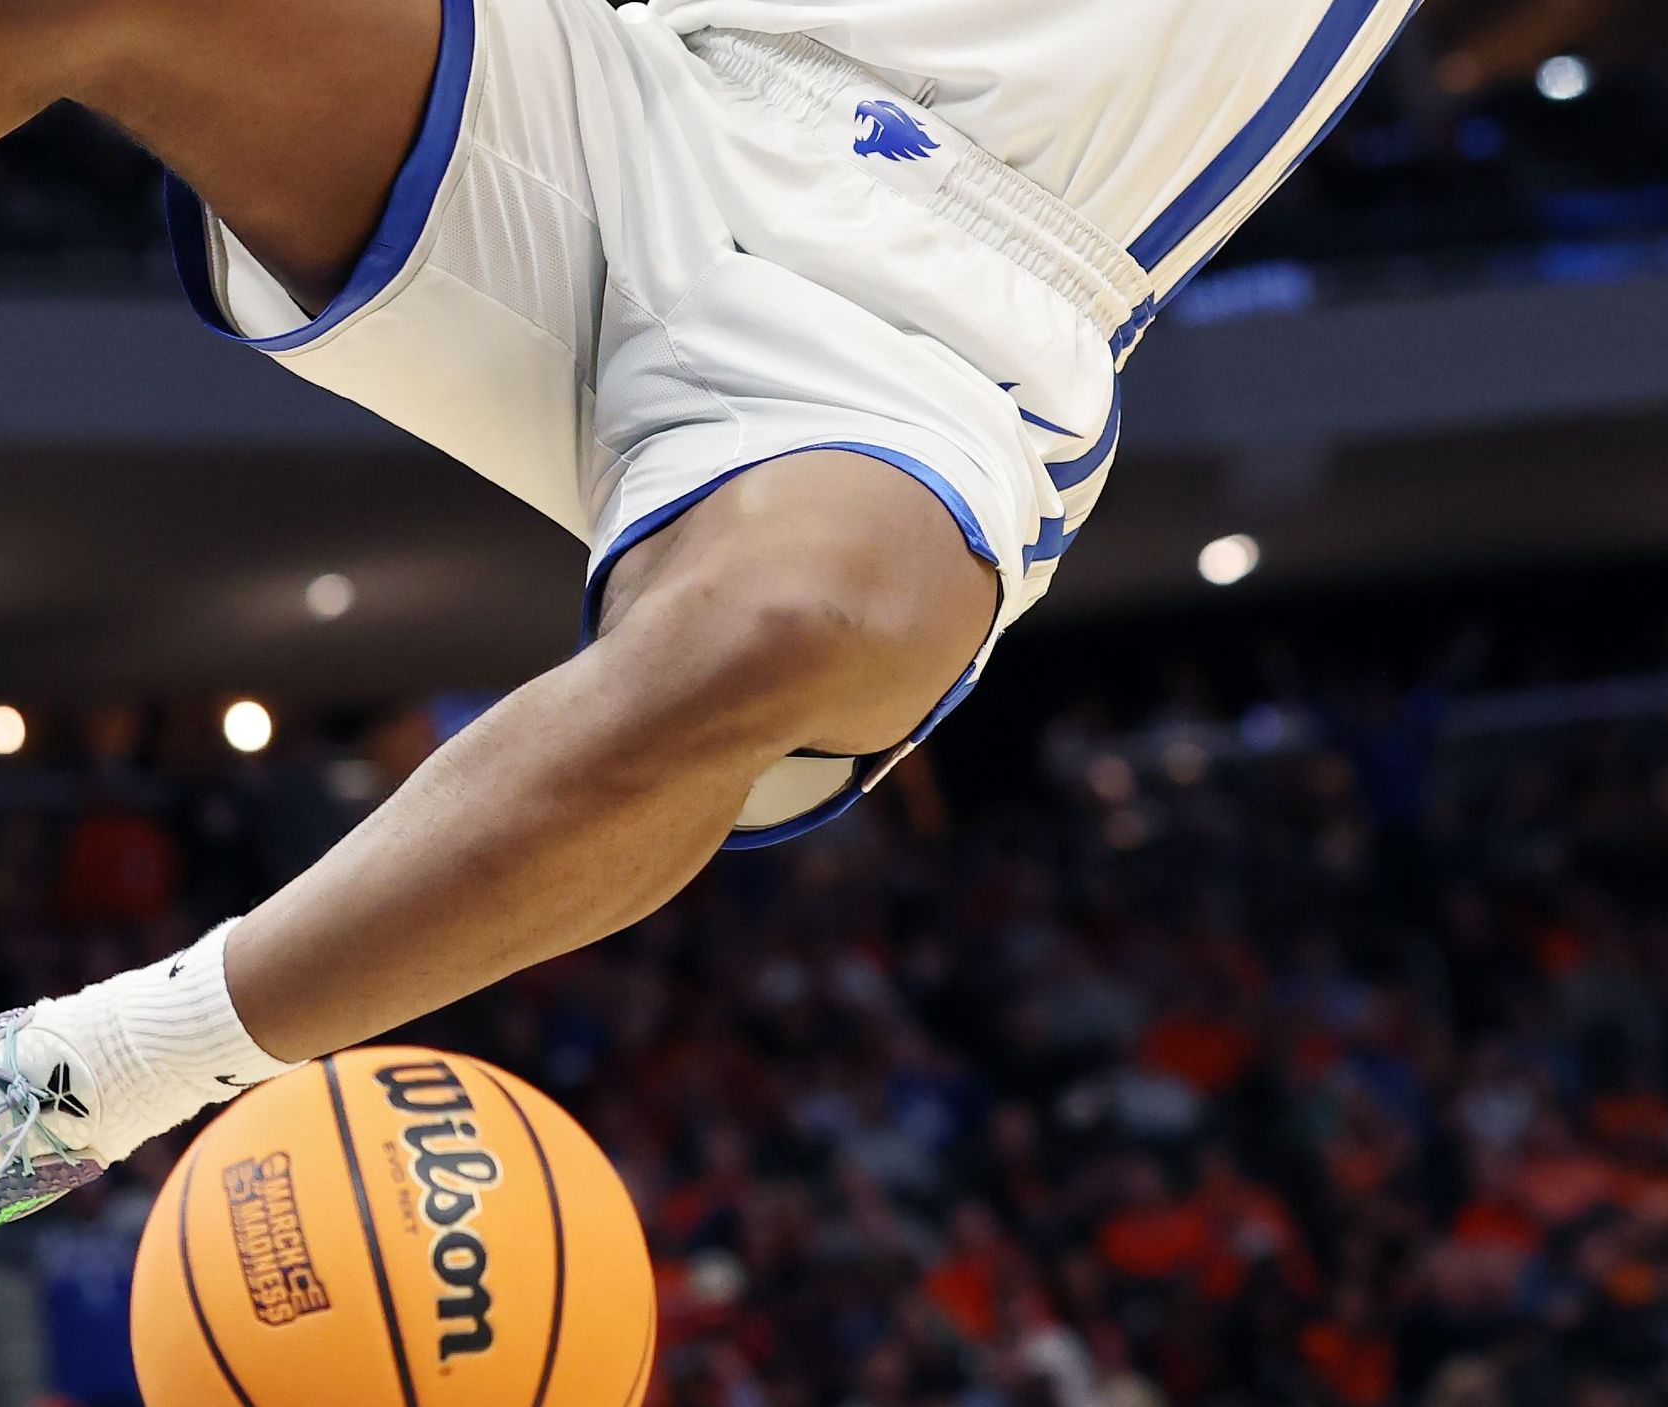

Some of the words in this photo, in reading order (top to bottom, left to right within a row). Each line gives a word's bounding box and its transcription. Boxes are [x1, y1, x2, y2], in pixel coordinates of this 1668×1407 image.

[236, 1199, 292, 1325] MADNESS
[262, 1176, 310, 1269] MARCH
[373, 1060, 498, 1362] Wilson
